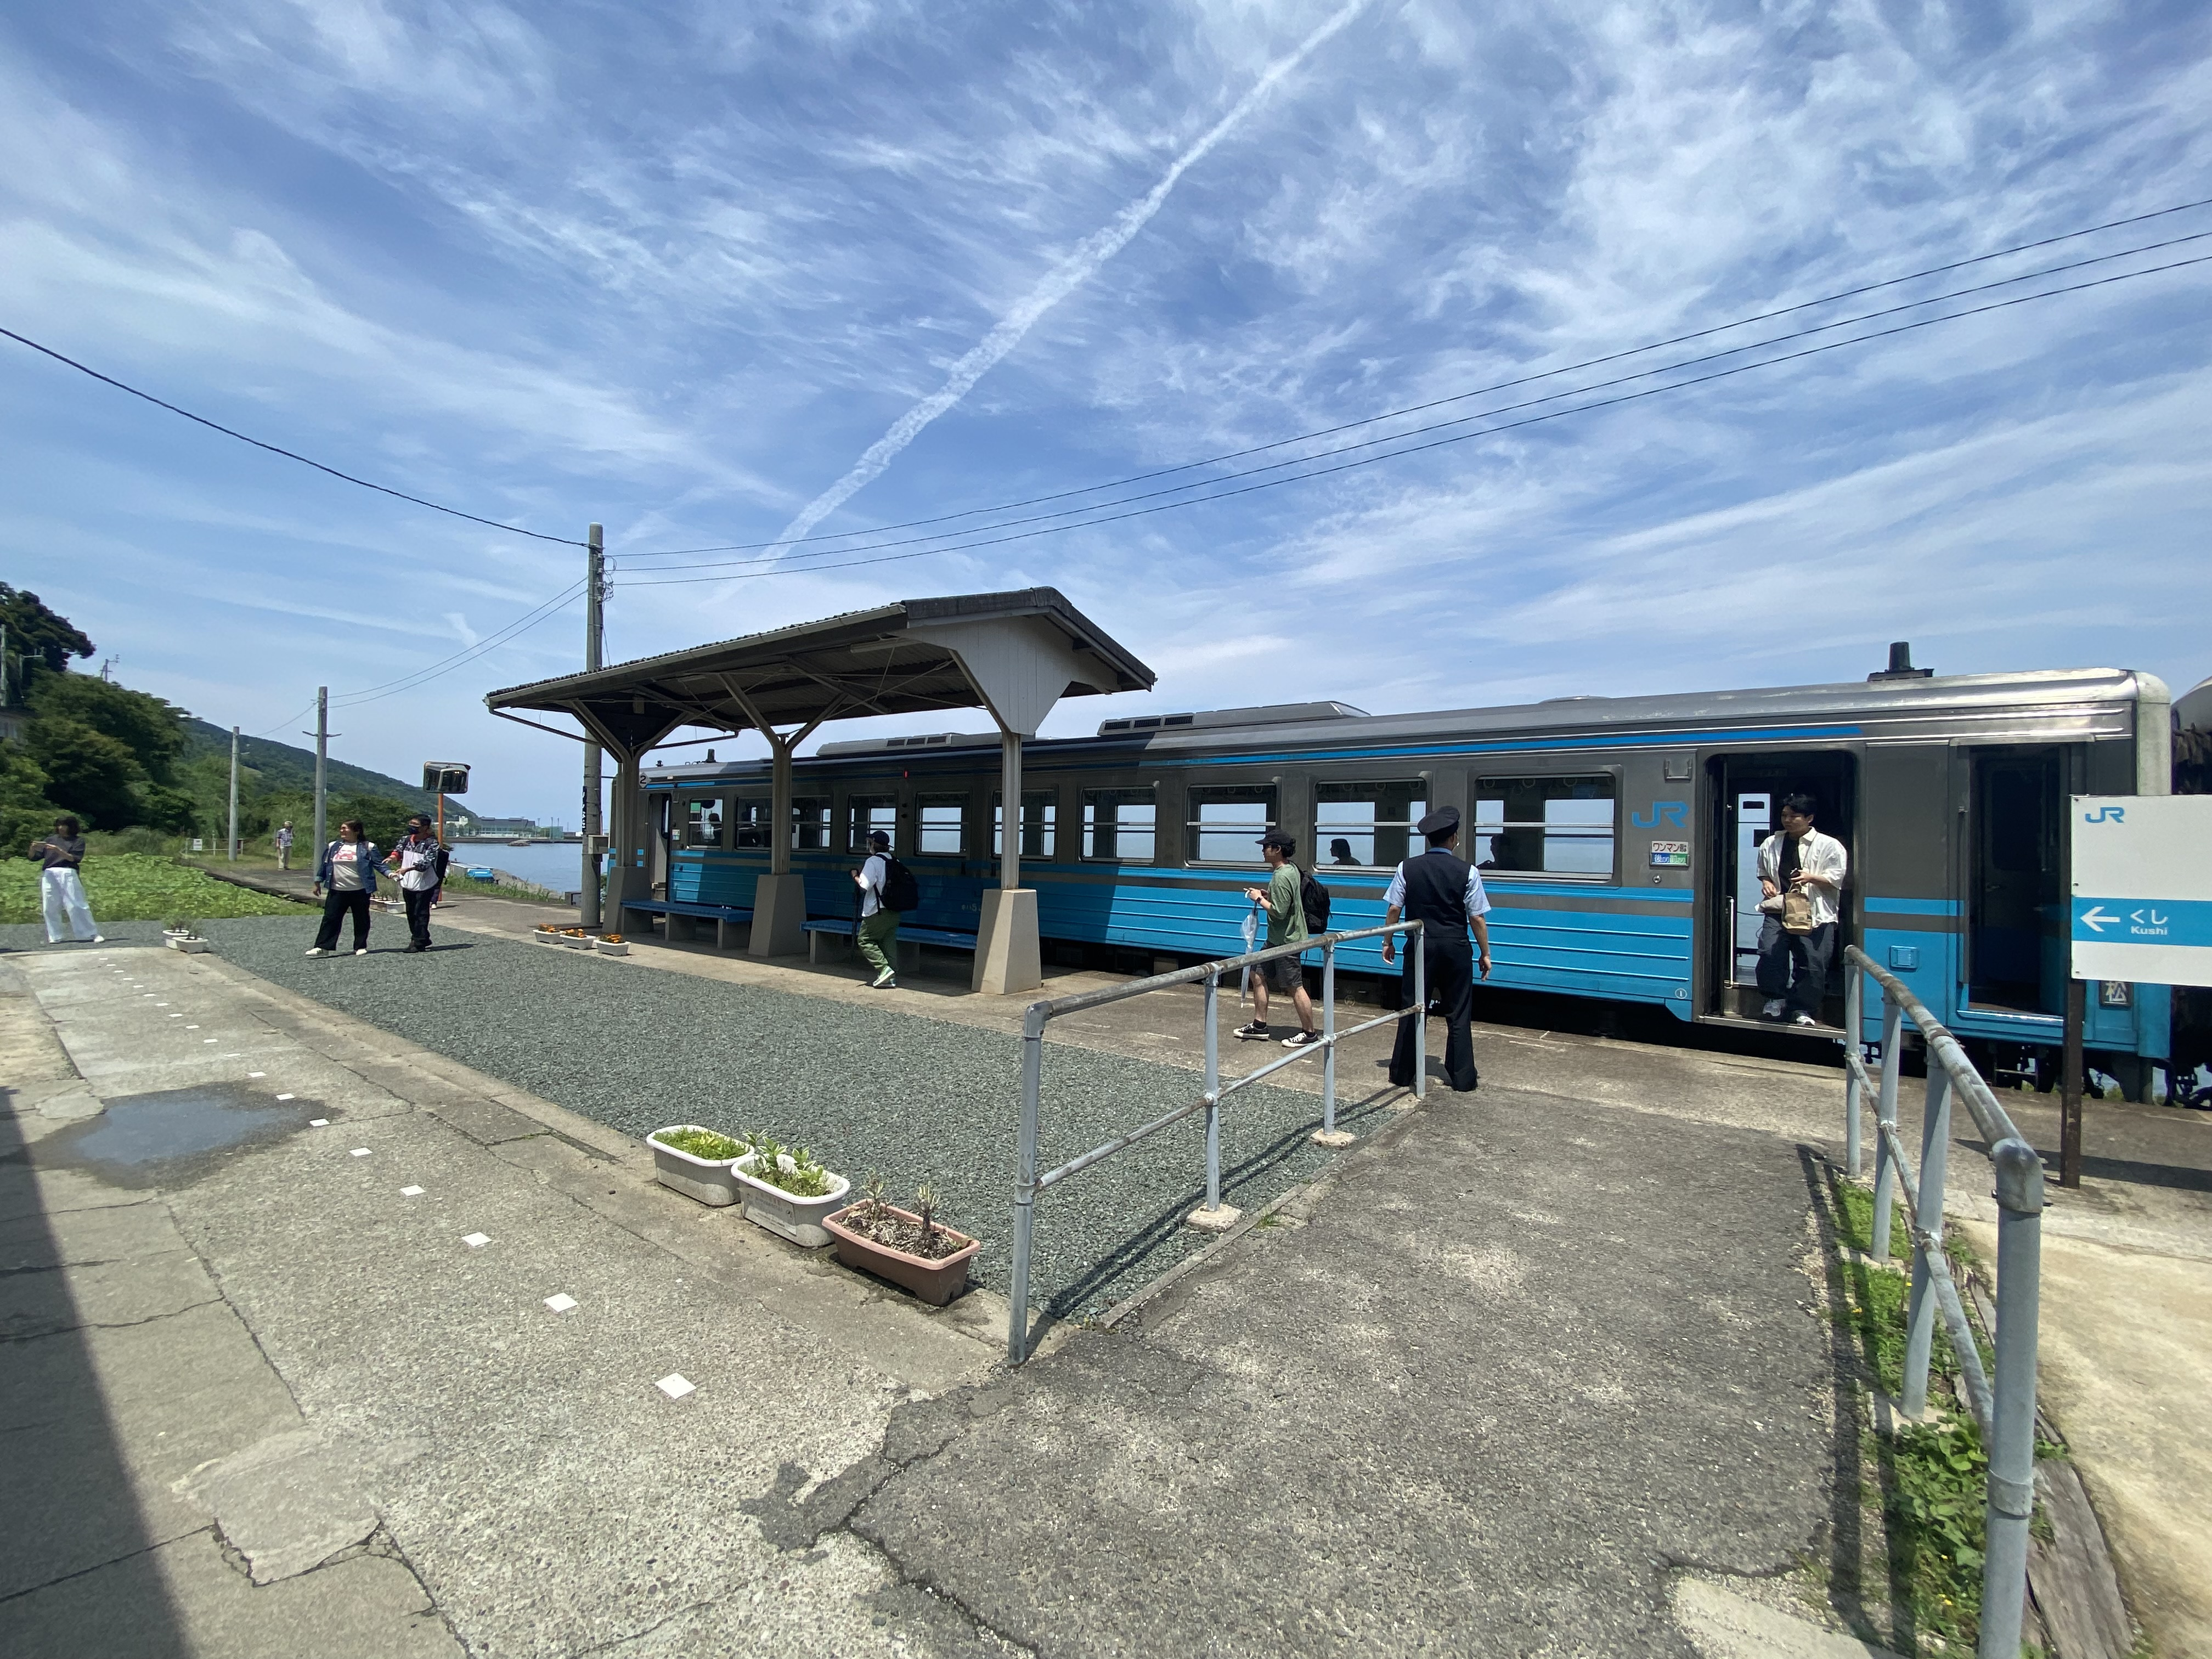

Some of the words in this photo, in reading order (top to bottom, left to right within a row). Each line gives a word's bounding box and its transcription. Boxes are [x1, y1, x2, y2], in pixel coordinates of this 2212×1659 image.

[640, 775, 646, 784] 2
[1632, 801, 1689, 828] JR
[2085, 807, 2124, 823] JR
[2130, 909, 2169, 924] くし
[2131, 926, 2169, 935] Kushi
[2105, 981, 2127, 1002] 松
